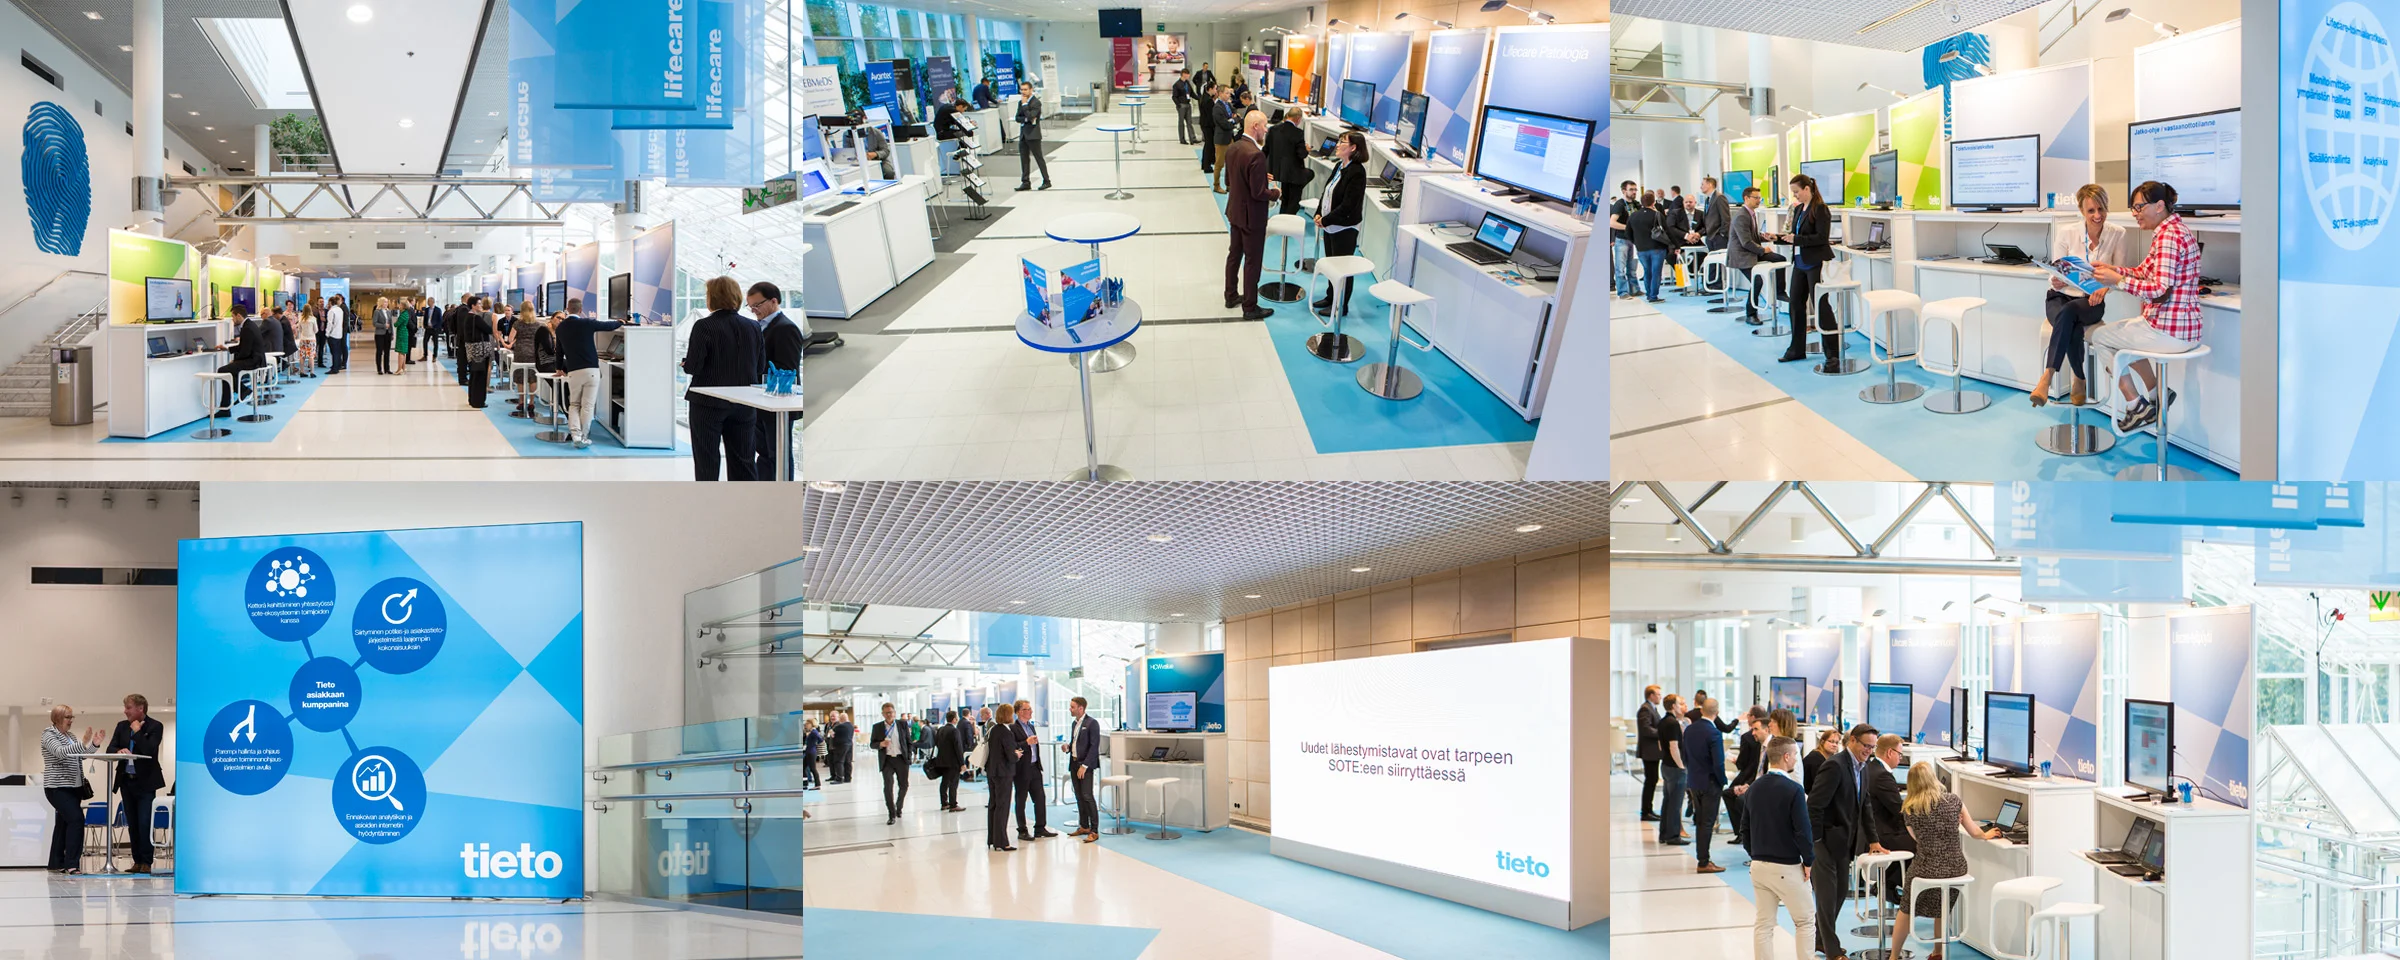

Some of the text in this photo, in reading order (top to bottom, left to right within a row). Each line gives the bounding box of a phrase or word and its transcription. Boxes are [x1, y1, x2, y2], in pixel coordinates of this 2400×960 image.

[1502, 45, 1589, 62] Lifecare Patologia
[706, 28, 722, 118] lifecare
[2134, 126, 2160, 136] Jatko-ohje
[2164, 119, 2216, 132] vastaanottotilanne
[1452, 146, 1464, 161] tieto
[1928, 195, 1940, 205] tieto
[251, 609, 300, 617] sote-ekosysteemin
[368, 636, 402, 644] järjestelmistä
[316, 681, 335, 689] Tieto
[302, 701, 349, 709] kumppanina
[215, 748, 237, 756] Parempi
[257, 748, 262, 756] ja
[263, 748, 280, 756] ohjaus
[1301, 742, 1513, 766] Uudet lähestymistavat ovat tarpeen
[212, 756, 238, 764] globaalien
[2078, 758, 2094, 774] tieto
[223, 764, 255, 772] järjestelmien
[1328, 759, 1466, 782] SOTE:een siirryttäessä
[2229, 780, 2247, 799] tieto
[378, 813, 406, 822] analytiikan
[358, 830, 400, 838] hyödyntäminen
[460, 843, 563, 879] tieto
[1496, 850, 1549, 878] tieto
